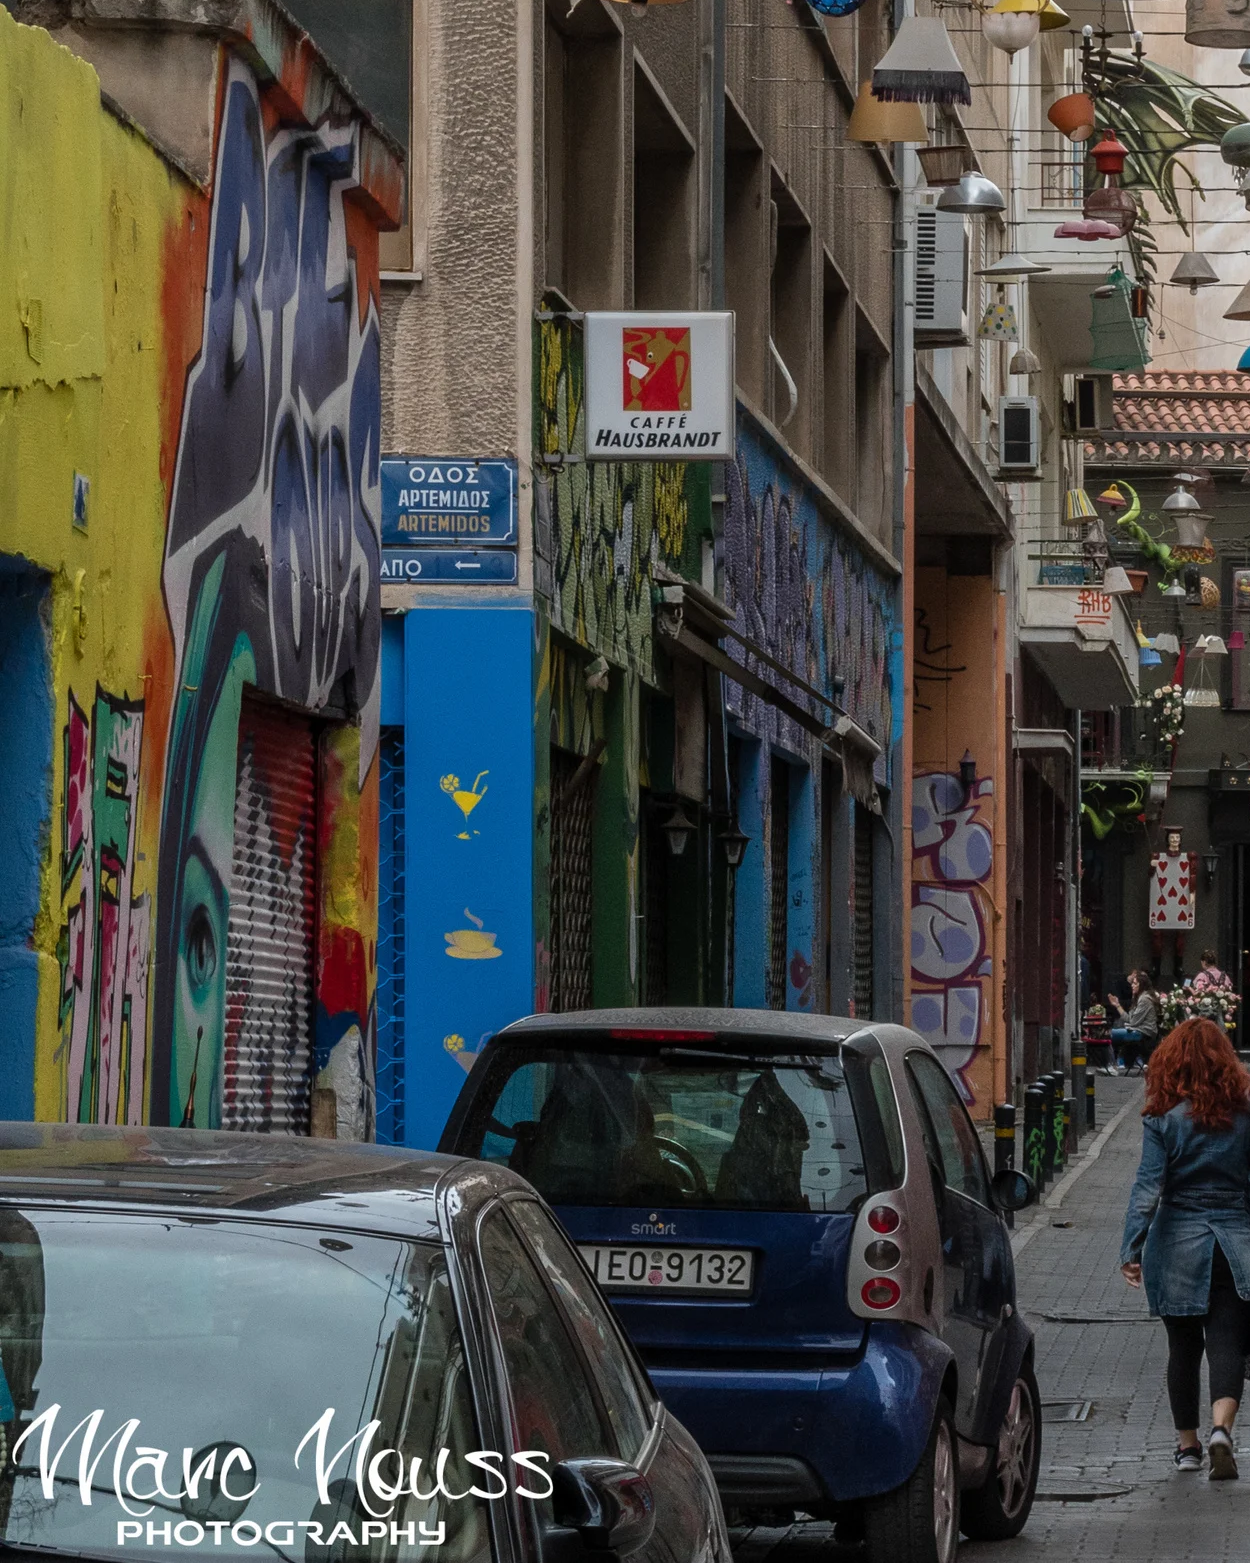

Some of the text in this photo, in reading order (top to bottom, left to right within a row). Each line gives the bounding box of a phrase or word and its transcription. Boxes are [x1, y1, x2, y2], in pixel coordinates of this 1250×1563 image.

[630, 413, 687, 429] CAFFÉ
[409, 466, 479, 484] ΟΔΟΣ
[398, 489, 490, 508] ΑΡΤΕΜΙΔΟΣ
[397, 514, 491, 533] ARTEMIDOS
[380, 559, 422, 577] ΑΠΟ
[631, 1221, 677, 1236] smart
